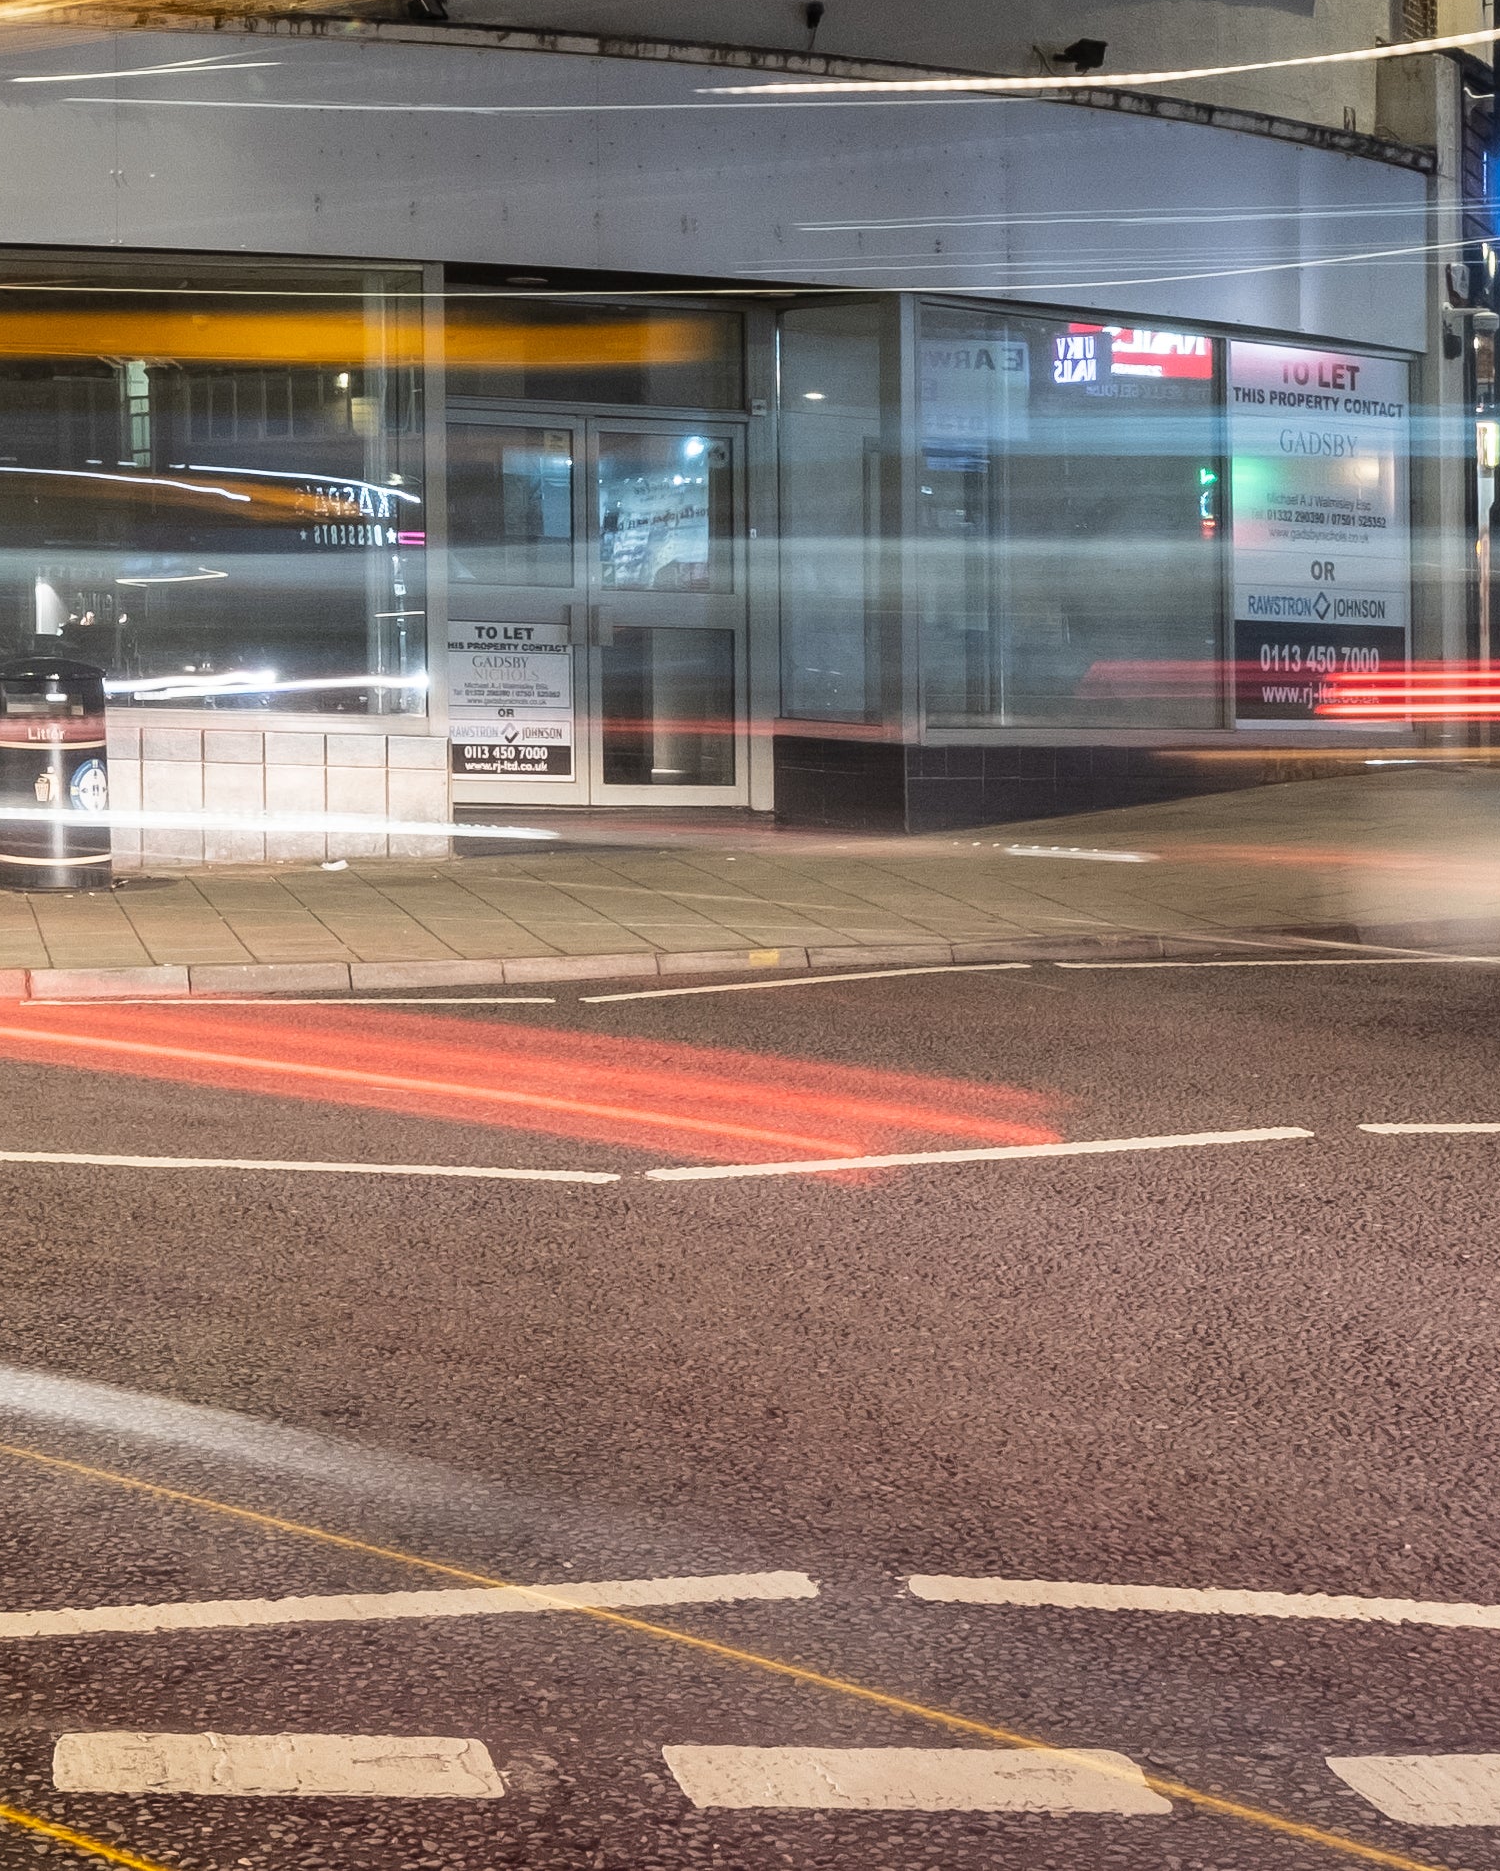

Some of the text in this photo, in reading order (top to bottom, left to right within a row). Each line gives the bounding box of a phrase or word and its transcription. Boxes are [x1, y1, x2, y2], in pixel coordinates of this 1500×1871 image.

[1318, 362, 1360, 391] LET
[1233, 387, 1265, 404] THIS
[1269, 390, 1340, 412] PROPERTY
[1344, 398, 1404, 418] CONTACT
[1280, 429, 1358, 458] GADSBY
[1311, 560, 1335, 581] OR
[1248, 595, 1386, 619] RAWSTRON JOHNSON
[474, 626, 534, 640] TO LET
[467, 642, 519, 651] PROPERTY
[521, 644, 567, 653] CONTACT
[472, 655, 529, 669] GADSBY
[1260, 644, 1380, 673] 0113 450 7000
[498, 708, 515, 718] OR
[28, 727, 66, 740] Litter
[522, 726, 563, 740] JOHNSON
[464, 745, 548, 760] 0113 450 7000
